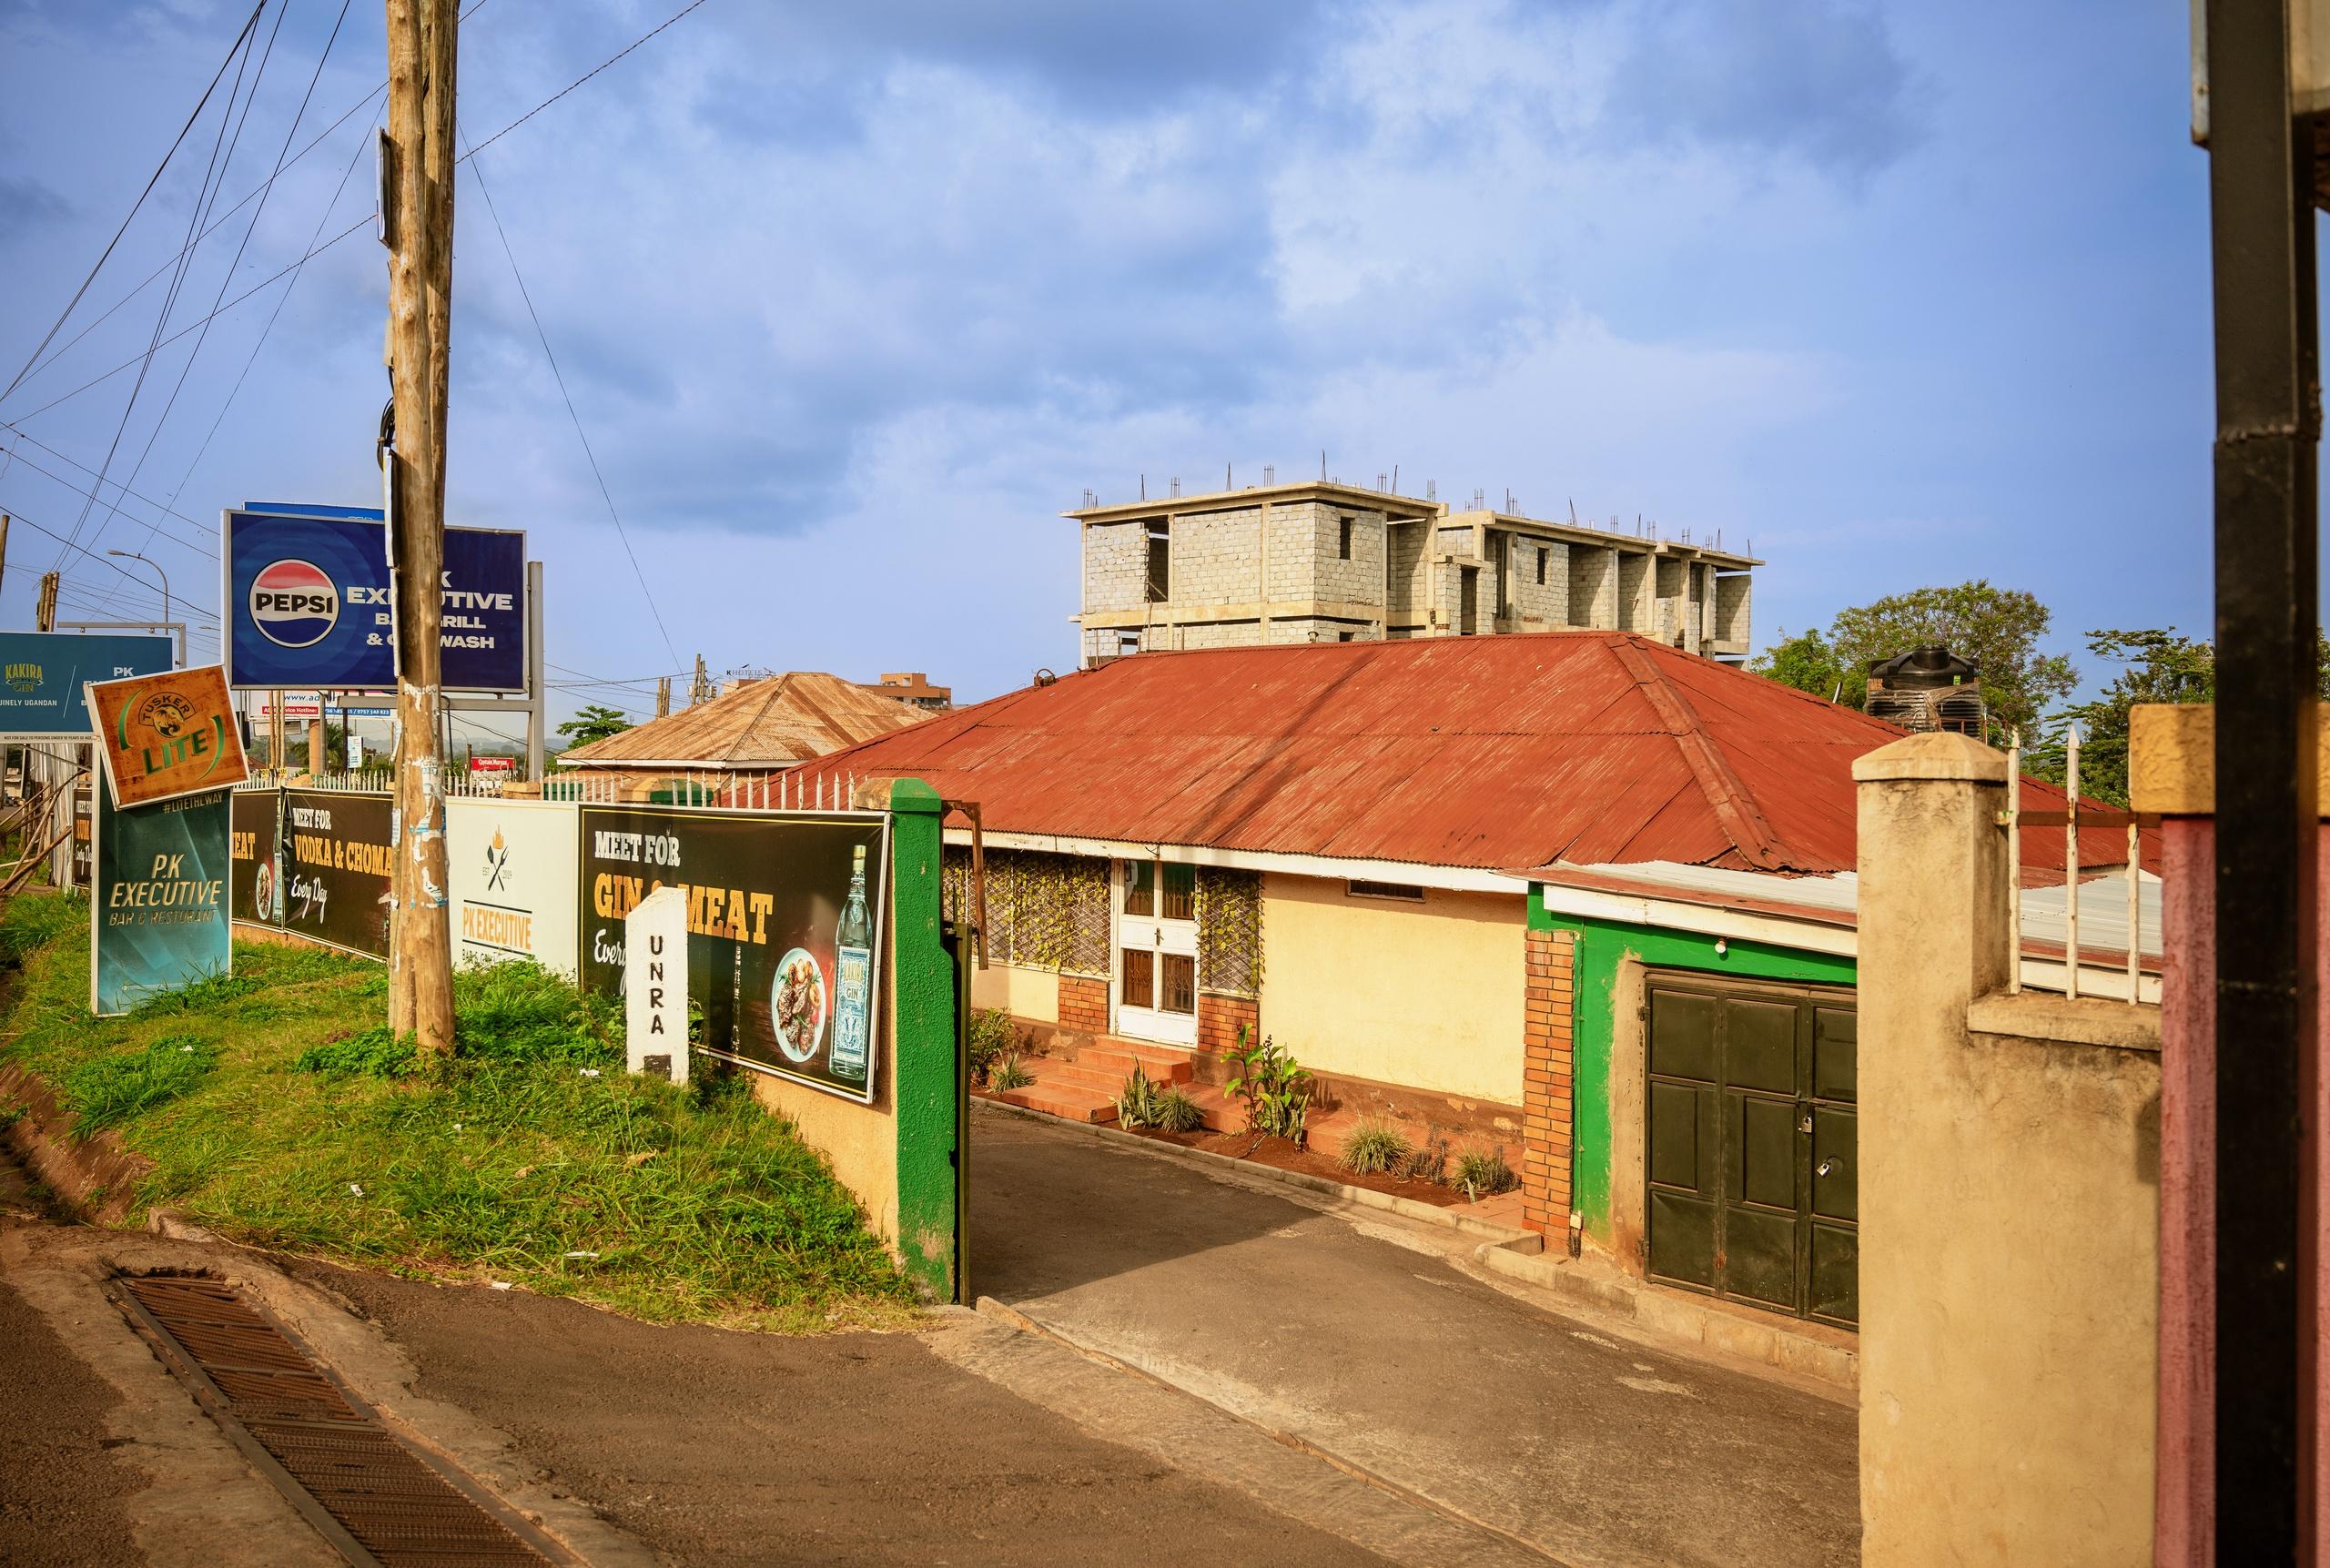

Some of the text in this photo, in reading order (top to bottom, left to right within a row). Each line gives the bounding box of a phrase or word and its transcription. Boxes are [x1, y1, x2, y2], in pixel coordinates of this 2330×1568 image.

[256, 592, 333, 614] PEPSI
[347, 586, 512, 611] EXTIVE
[441, 615, 486, 629] RILL
[366, 632, 383, 645] &
[5, 663, 43, 680] KAKIRA
[113, 667, 134, 677] PK
[143, 695, 190, 721] TUSKER
[142, 728, 209, 776] LITE
[163, 791, 224, 814] #LITETHEWAY
[293, 807, 332, 830] MEET FOR
[232, 832, 256, 860] EAT
[294, 835, 393, 877] VODKA & CHOMA
[594, 831, 681, 866] MEET FOR
[151, 854, 185, 879] P.K
[109, 880, 223, 907] EXECUTIVE
[291, 874, 328, 924] Every Day
[109, 911, 134, 926] BAR
[594, 873, 774, 945] GIN MEAT
[462, 906, 532, 951] PK EXECUTIVE
[649, 935, 664, 1036] UNRA
[846, 987, 859, 1000] GIN
